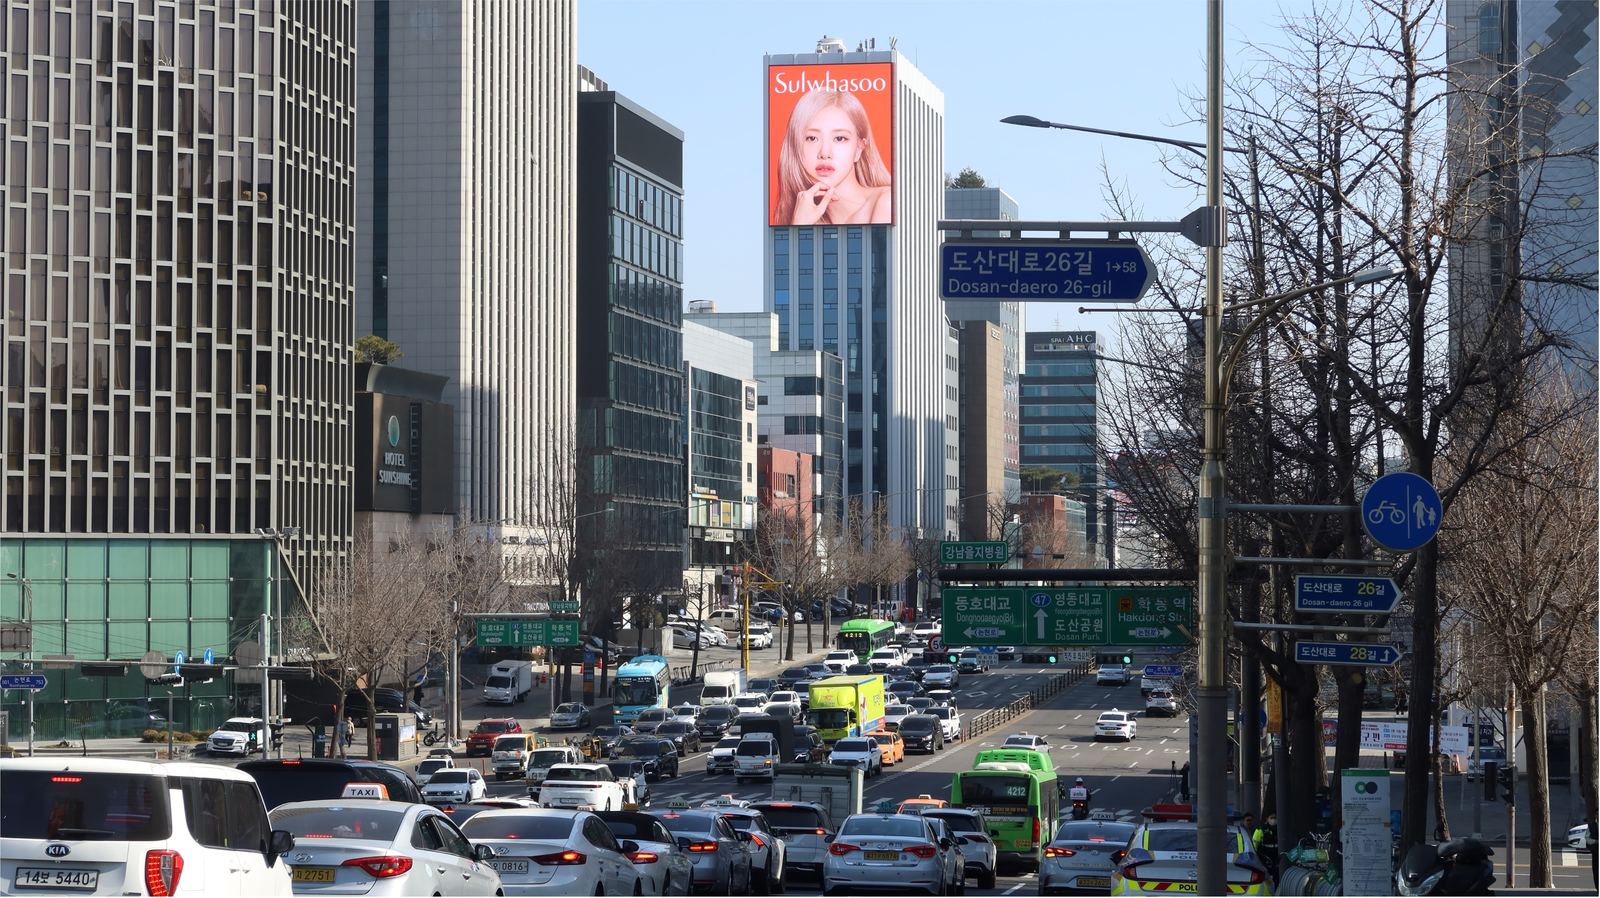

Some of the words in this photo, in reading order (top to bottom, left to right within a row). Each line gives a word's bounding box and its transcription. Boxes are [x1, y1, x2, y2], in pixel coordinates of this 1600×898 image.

[775, 70, 886, 93] Sulwhasoo
[949, 250, 1093, 276] 도산대로26길
[949, 279, 1058, 294] Dosan-daero
[1063, 279, 1112, 297] 26-gil
[1067, 334, 1092, 343] AHC
[385, 452, 406, 466] HOTEL
[379, 469, 412, 485] SUNSHINE
[945, 545, 1004, 559] 강남을지병원
[1303, 583, 1343, 593] 도산대로
[955, 596, 1011, 611] 동호대교
[1034, 595, 1046, 605] 47
[1055, 592, 1102, 607] 영동대교
[1118, 612, 1166, 624] Hakdong
[1055, 618, 1103, 632] 도산공원
[1056, 633, 1079, 641] Dosan
[1082, 633, 1100, 641] Park
[1301, 647, 1336, 657] 도산대로
[1008, 787, 1026, 796] 4212
[48, 846, 66, 854] KIA
[502, 863, 523, 871] 0816
[56, 872, 89, 885] 5440
[304, 870, 330, 881] 2751
